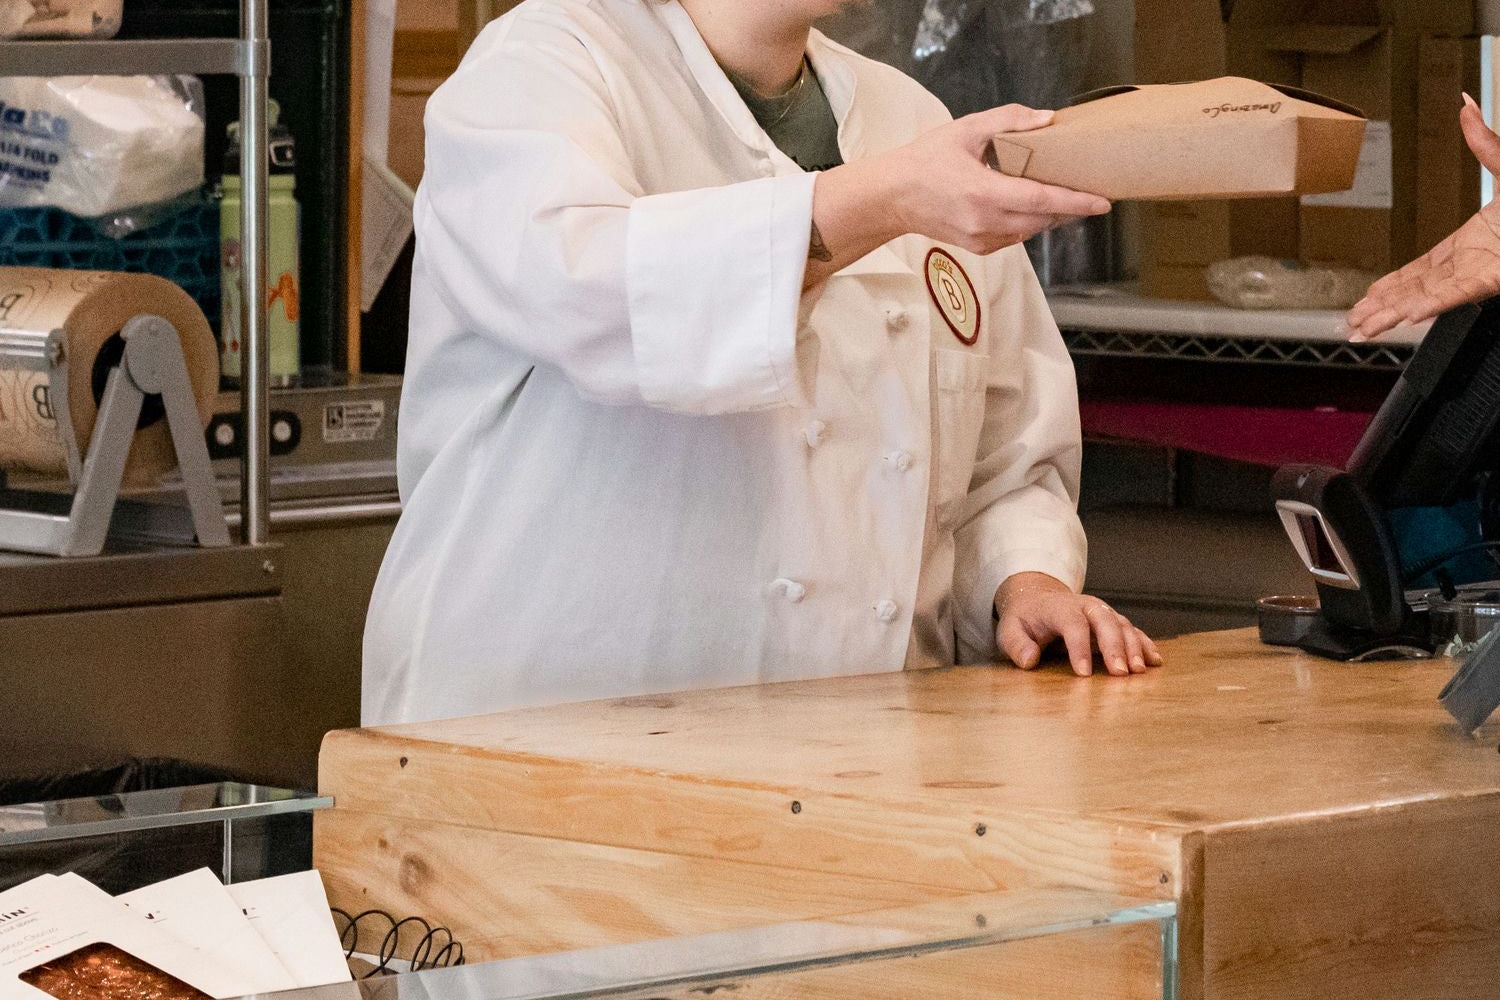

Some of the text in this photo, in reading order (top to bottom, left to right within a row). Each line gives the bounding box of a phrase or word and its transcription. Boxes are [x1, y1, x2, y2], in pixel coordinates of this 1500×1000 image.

[24, 147, 59, 165] FOLD
[941, 278, 962, 311] B
[33, 384, 56, 420] B
